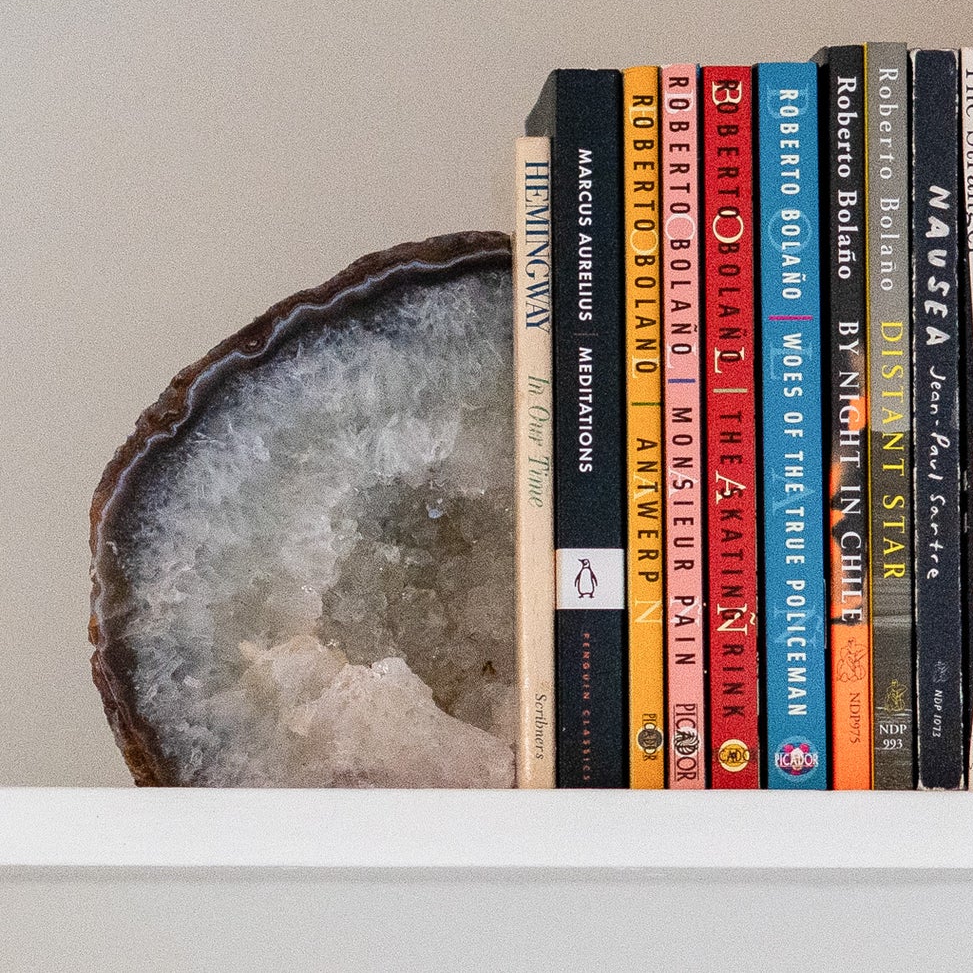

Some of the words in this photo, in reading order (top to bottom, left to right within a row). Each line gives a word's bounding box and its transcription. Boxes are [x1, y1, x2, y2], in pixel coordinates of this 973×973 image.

[632, 95, 655, 232] ROBERTO
[668, 76, 690, 214] ROBERTO
[718, 79, 740, 218] ROBERTO
[779, 89, 799, 196] ROBERTO
[837, 76, 857, 178] Roberto
[878, 68, 899, 179] Roberto
[578, 149, 592, 226] MARCUS
[525, 161, 550, 335] HEMINGWAY
[781, 209, 806, 299] BOLAÑO
[838, 190, 858, 279] Bolaño
[879, 198, 900, 291] Bolaño
[924, 186, 950, 346] NAUSEA
[579, 233, 592, 321] AURELIUS
[670, 239, 698, 355] BOLAÑO
[783, 333, 802, 399] WOES
[838, 321, 859, 355] BY
[528, 375, 549, 397] In
[528, 404, 551, 445] Our
[579, 347, 592, 473] MEDITATIONS
[784, 412, 802, 437] OF
[839, 372, 860, 468] NIGHT
[881, 322, 904, 476] DISTANT
[929, 366, 950, 480] Jean-Paul
[720, 412, 742, 464] THE
[784, 452, 803, 493] THE
[528, 456, 549, 507] Time
[636, 438, 659, 583] ANTWERP
[672, 407, 694, 571] MONSIEUR
[841, 486, 861, 514] IN
[786, 509, 804, 564] TRUE
[841, 531, 862, 623] CHILE
[882, 495, 905, 578] STAR
[927, 494, 947, 579] Sartre
[582, 633, 590, 701] PENGUIN
[674, 596, 696, 665] PAIN
[786, 581, 806, 716] POLICEMAN
[722, 644, 744, 717] RINK
[849, 692, 860, 743] NDP975
[933, 689, 942, 710] NDP
[534, 694, 547, 760] Scribners
[582, 709, 591, 781] CLASSICS
[879, 724, 908, 735] NDP
[883, 738, 903, 749] 993
[932, 714, 941, 738] 1073
